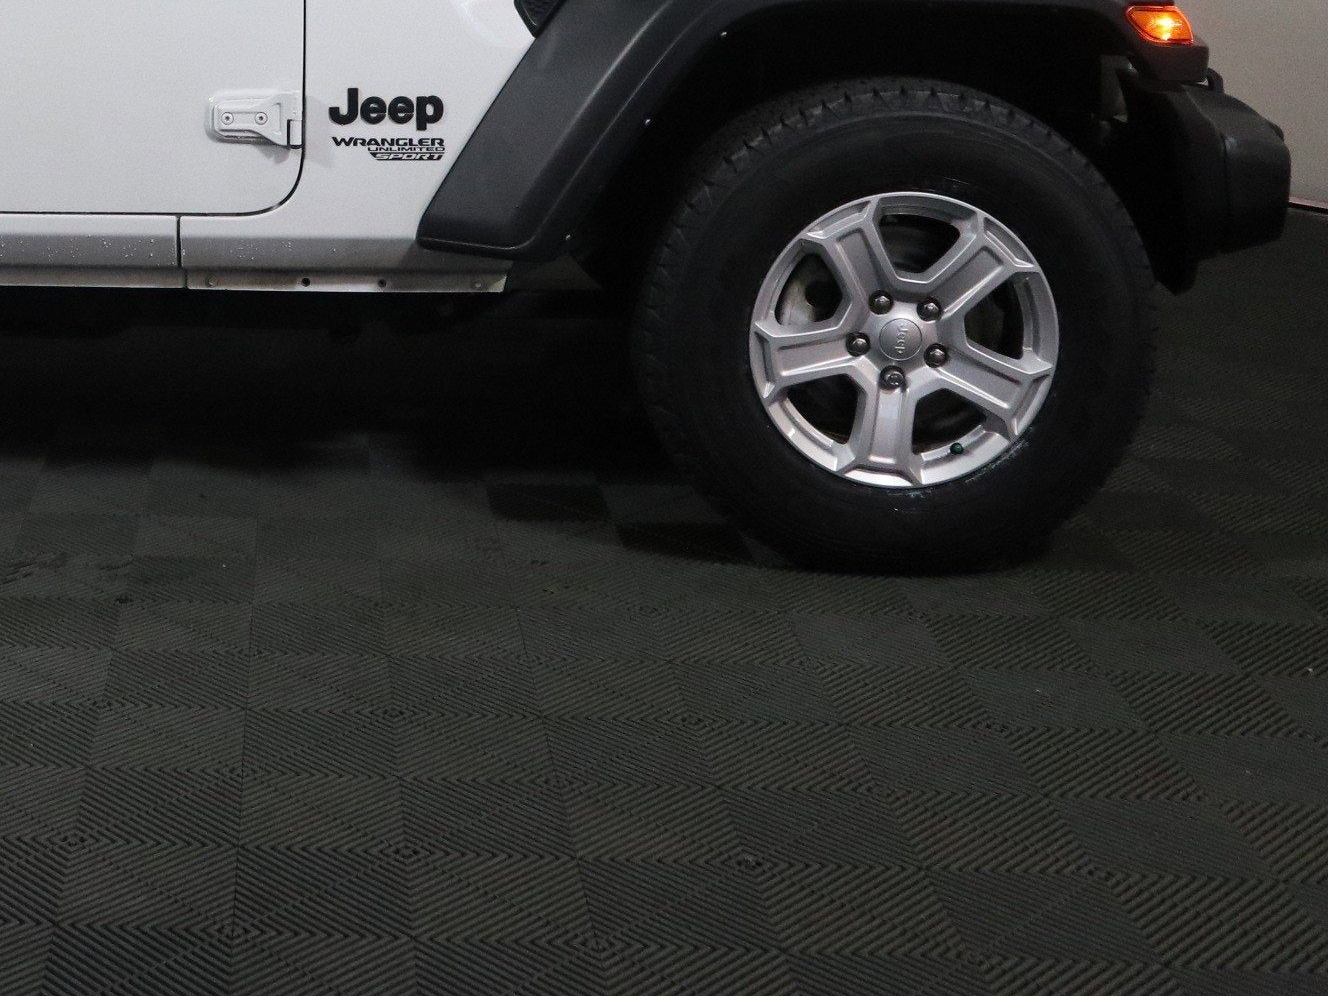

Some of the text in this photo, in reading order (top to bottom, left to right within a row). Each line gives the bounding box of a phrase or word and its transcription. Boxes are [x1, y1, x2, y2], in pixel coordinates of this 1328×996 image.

[328, 87, 444, 131] Jeep
[331, 136, 445, 147] WRANGLER
[374, 152, 444, 161] SPORT
[894, 325, 910, 354] Jeep
